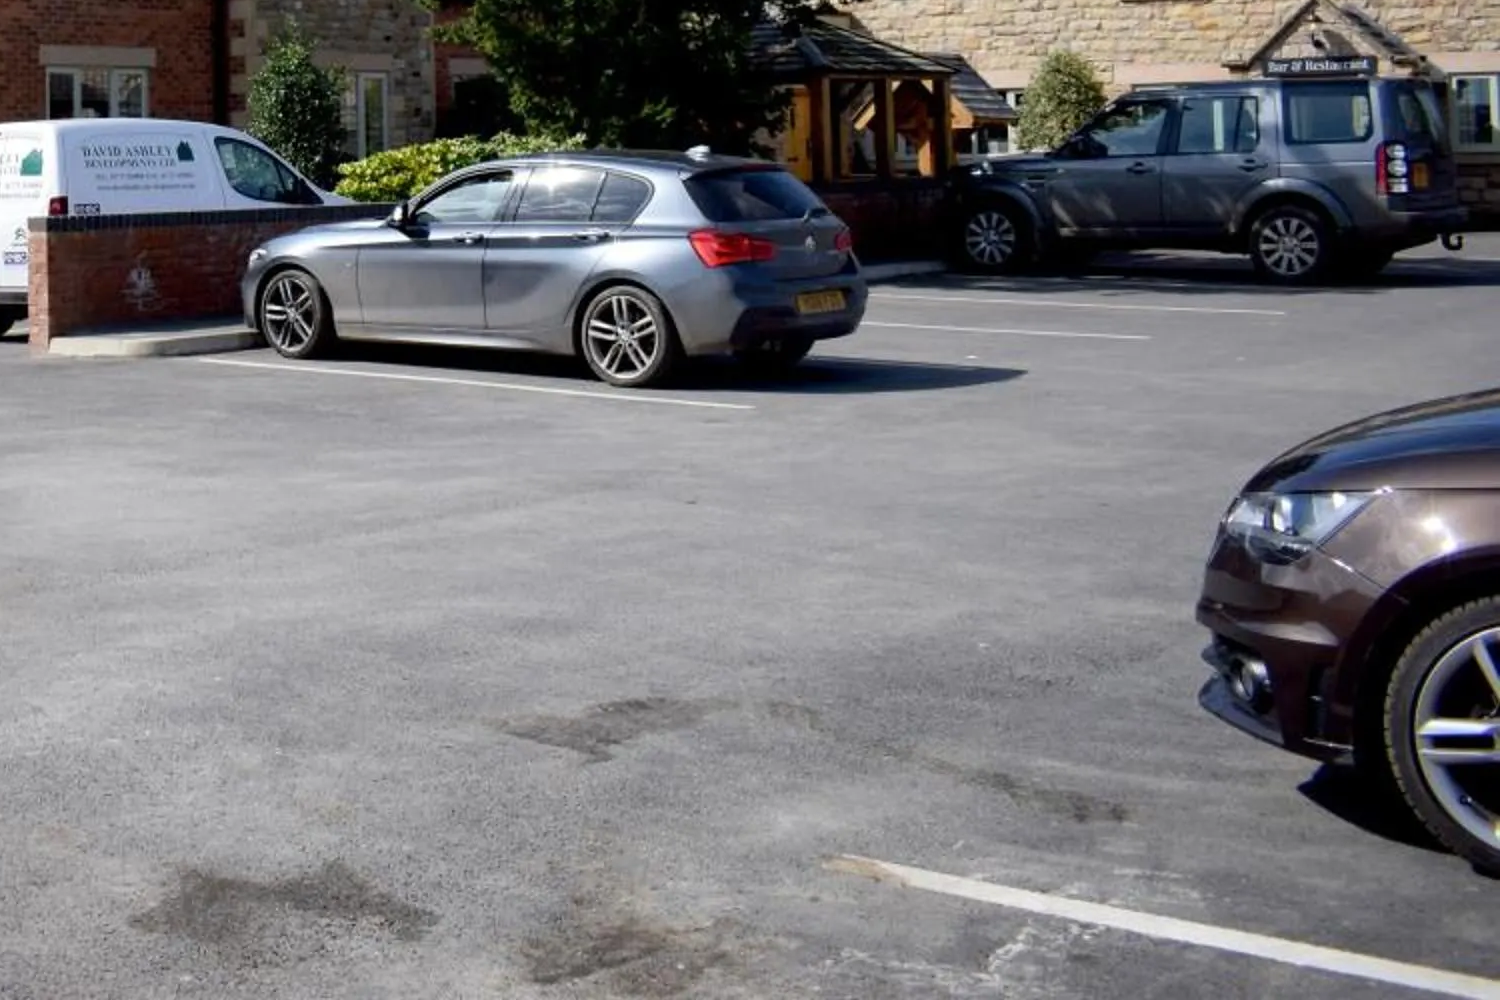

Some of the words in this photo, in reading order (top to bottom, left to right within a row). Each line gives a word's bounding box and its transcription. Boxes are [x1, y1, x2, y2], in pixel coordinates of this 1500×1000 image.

[1267, 61, 1289, 73] Bar
[1305, 59, 1369, 71] Restaurant
[82, 145, 121, 157] DAVID
[125, 144, 172, 157] ASHLEY
